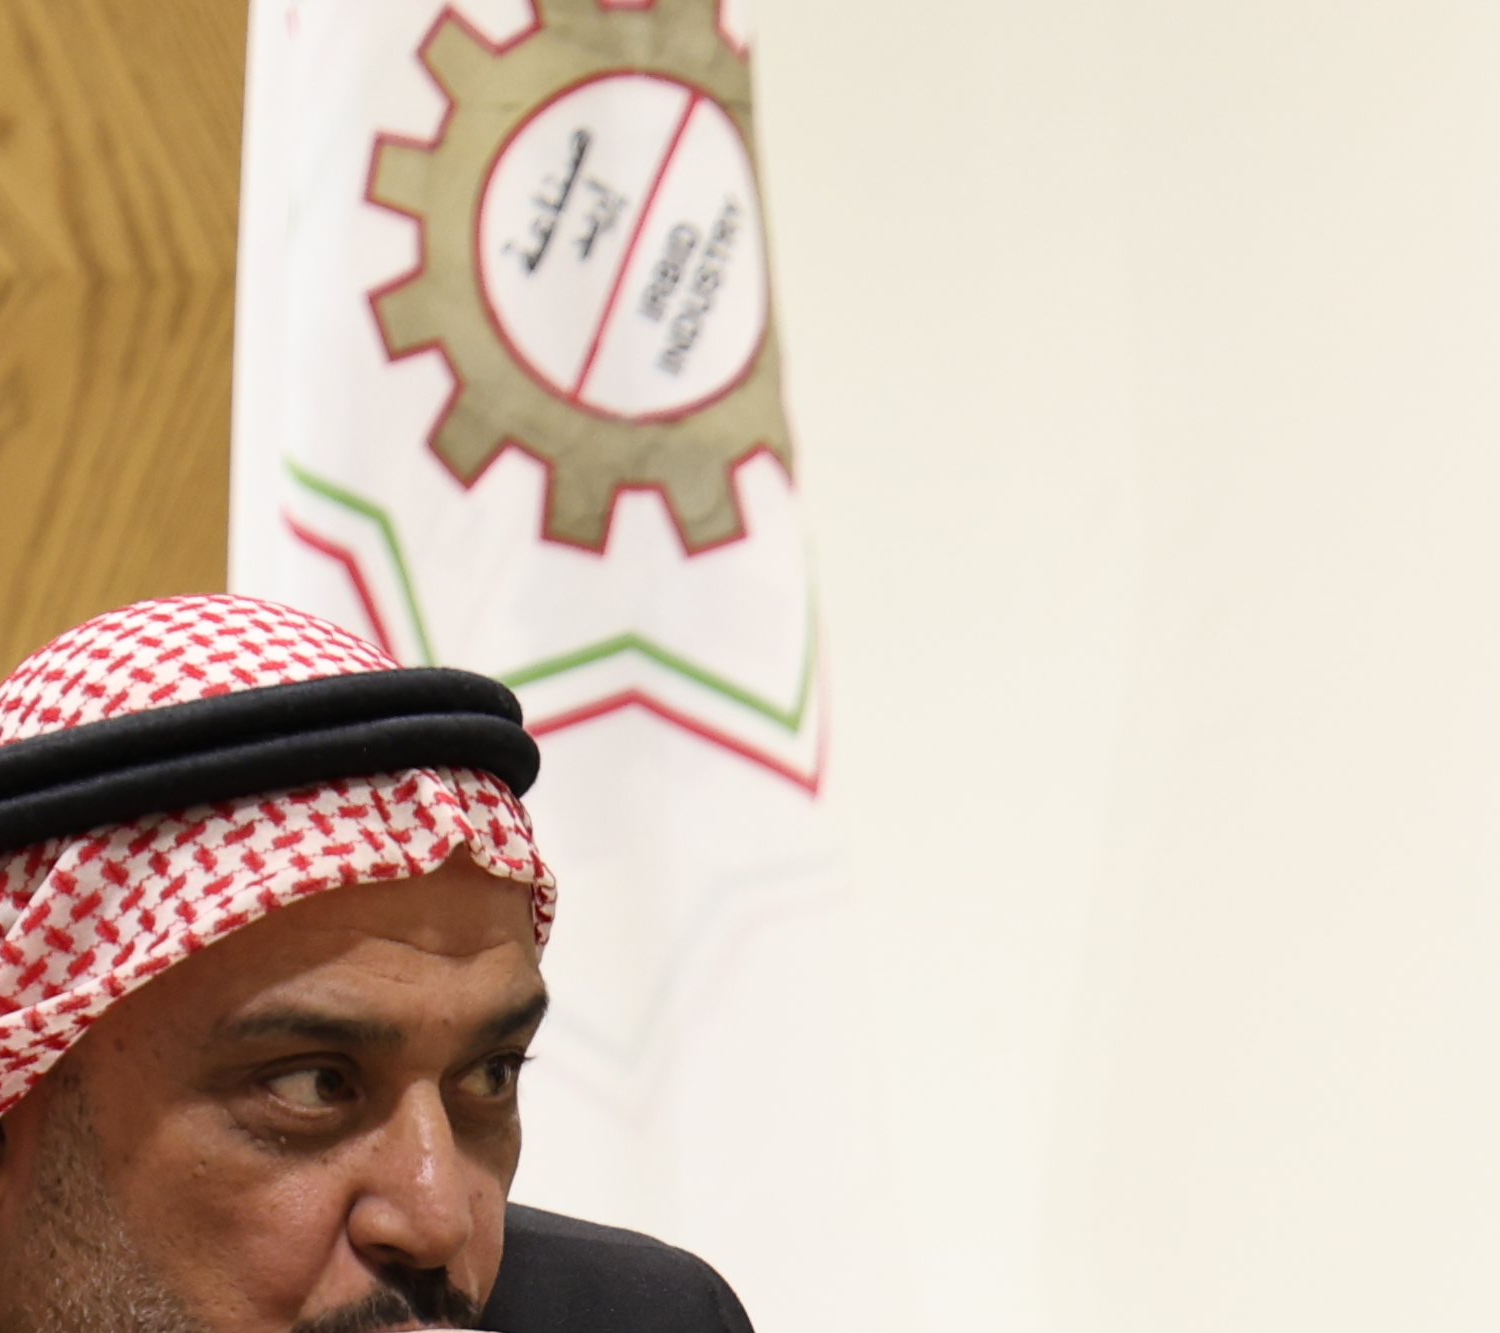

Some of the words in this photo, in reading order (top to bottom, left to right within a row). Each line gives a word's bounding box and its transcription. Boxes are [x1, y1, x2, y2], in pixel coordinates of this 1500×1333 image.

[502, 128, 591, 277] صناعة
[639, 222, 697, 322] IRBID
[656, 195, 742, 376] INDUSTRY
